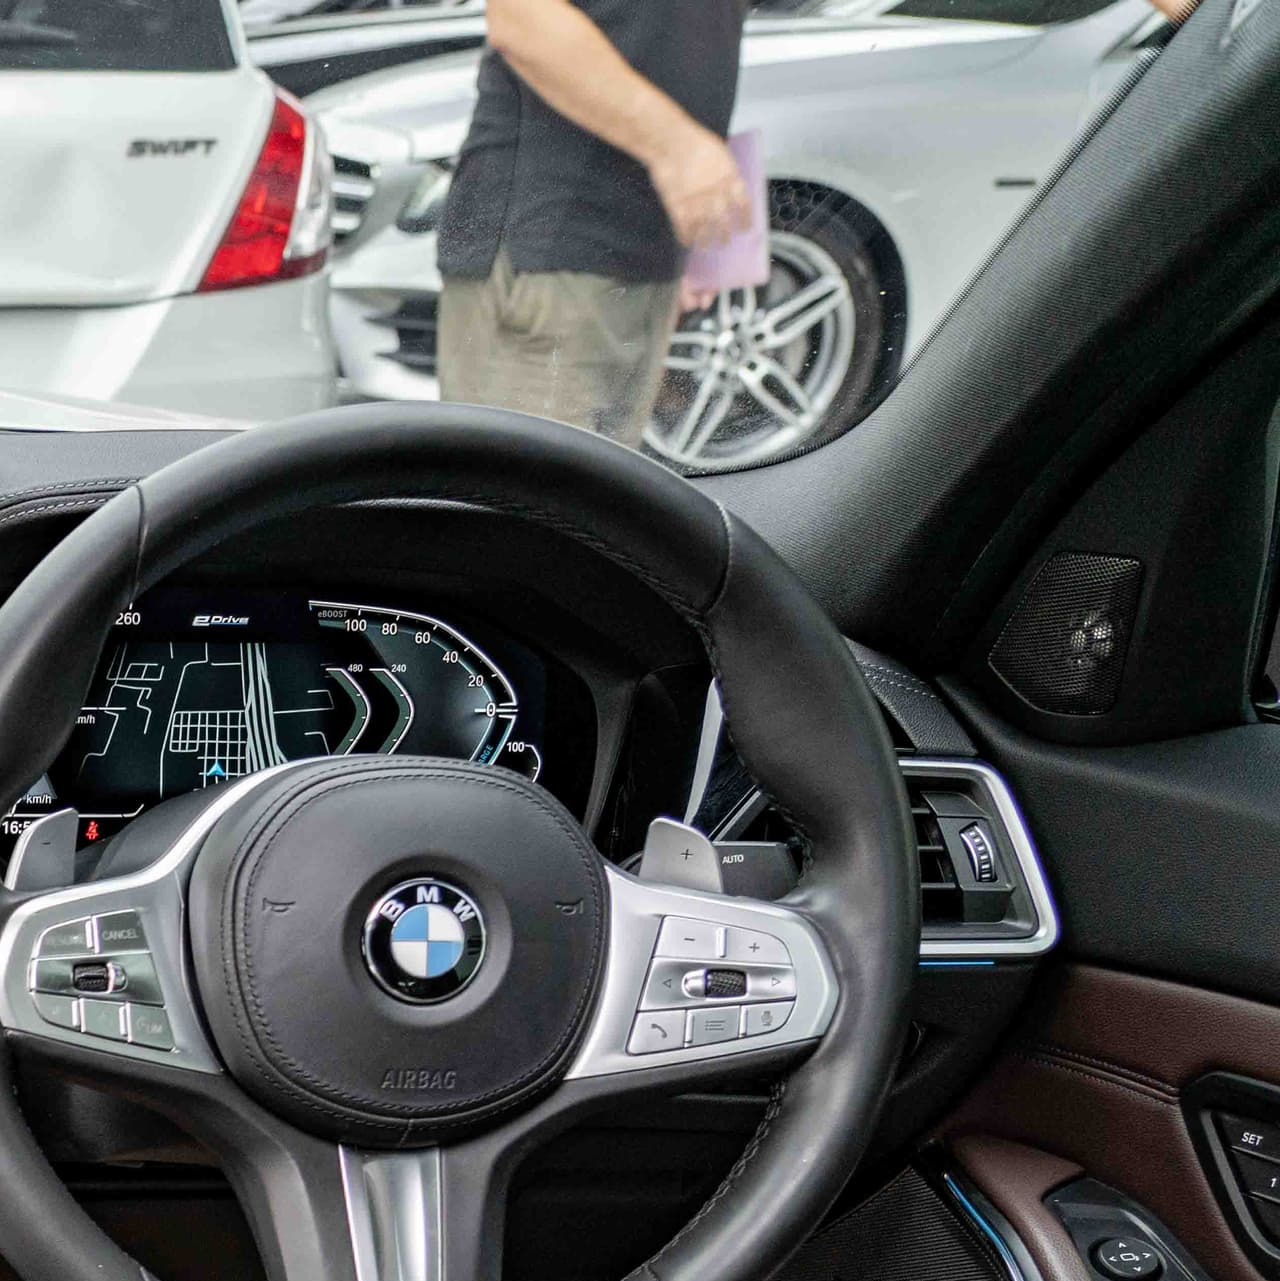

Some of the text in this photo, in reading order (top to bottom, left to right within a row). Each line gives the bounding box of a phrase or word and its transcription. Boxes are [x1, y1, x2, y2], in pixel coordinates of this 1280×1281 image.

[114, 612, 141, 626] 260
[191, 614, 250, 627] eDrive
[317, 609, 349, 619] eBOOST
[344, 619, 368, 632] 100
[381, 623, 398, 636] 80
[414, 631, 432, 645] 60
[442, 650, 460, 664] 40
[347, 664, 363, 673] 480
[391, 664, 407, 673] 240
[467, 674, 484, 688] 20
[486, 703, 496, 717] 0
[506, 742, 526, 753] 100
[25, 793, 53, 805] km/h
[1, 820, 32, 835] 16:5
[721, 854, 744, 865] AUTO
[378, 885, 477, 922] BMW
[380, 1070, 458, 1090] AIRBAG
[1240, 1131, 1264, 1147] SET
[1270, 1177, 1278, 1189] 1
